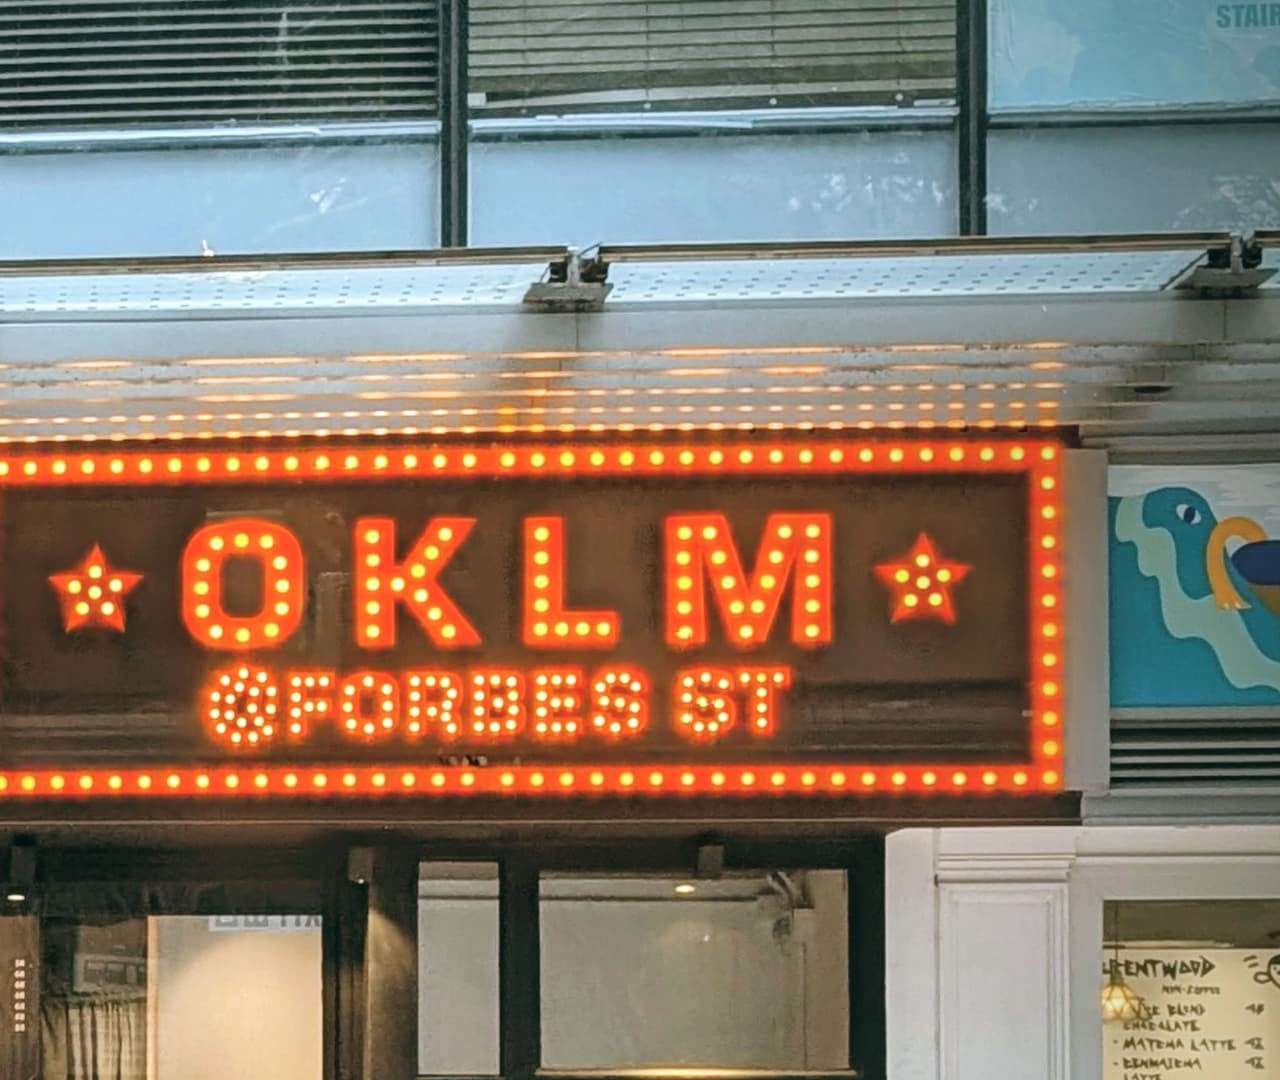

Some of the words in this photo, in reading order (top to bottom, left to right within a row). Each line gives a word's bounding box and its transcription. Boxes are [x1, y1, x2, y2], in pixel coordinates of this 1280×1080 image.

[181, 511, 833, 650] OKLM
[674, 664, 792, 738] ST
[1191, 1038, 1236, 1051] LATTE
